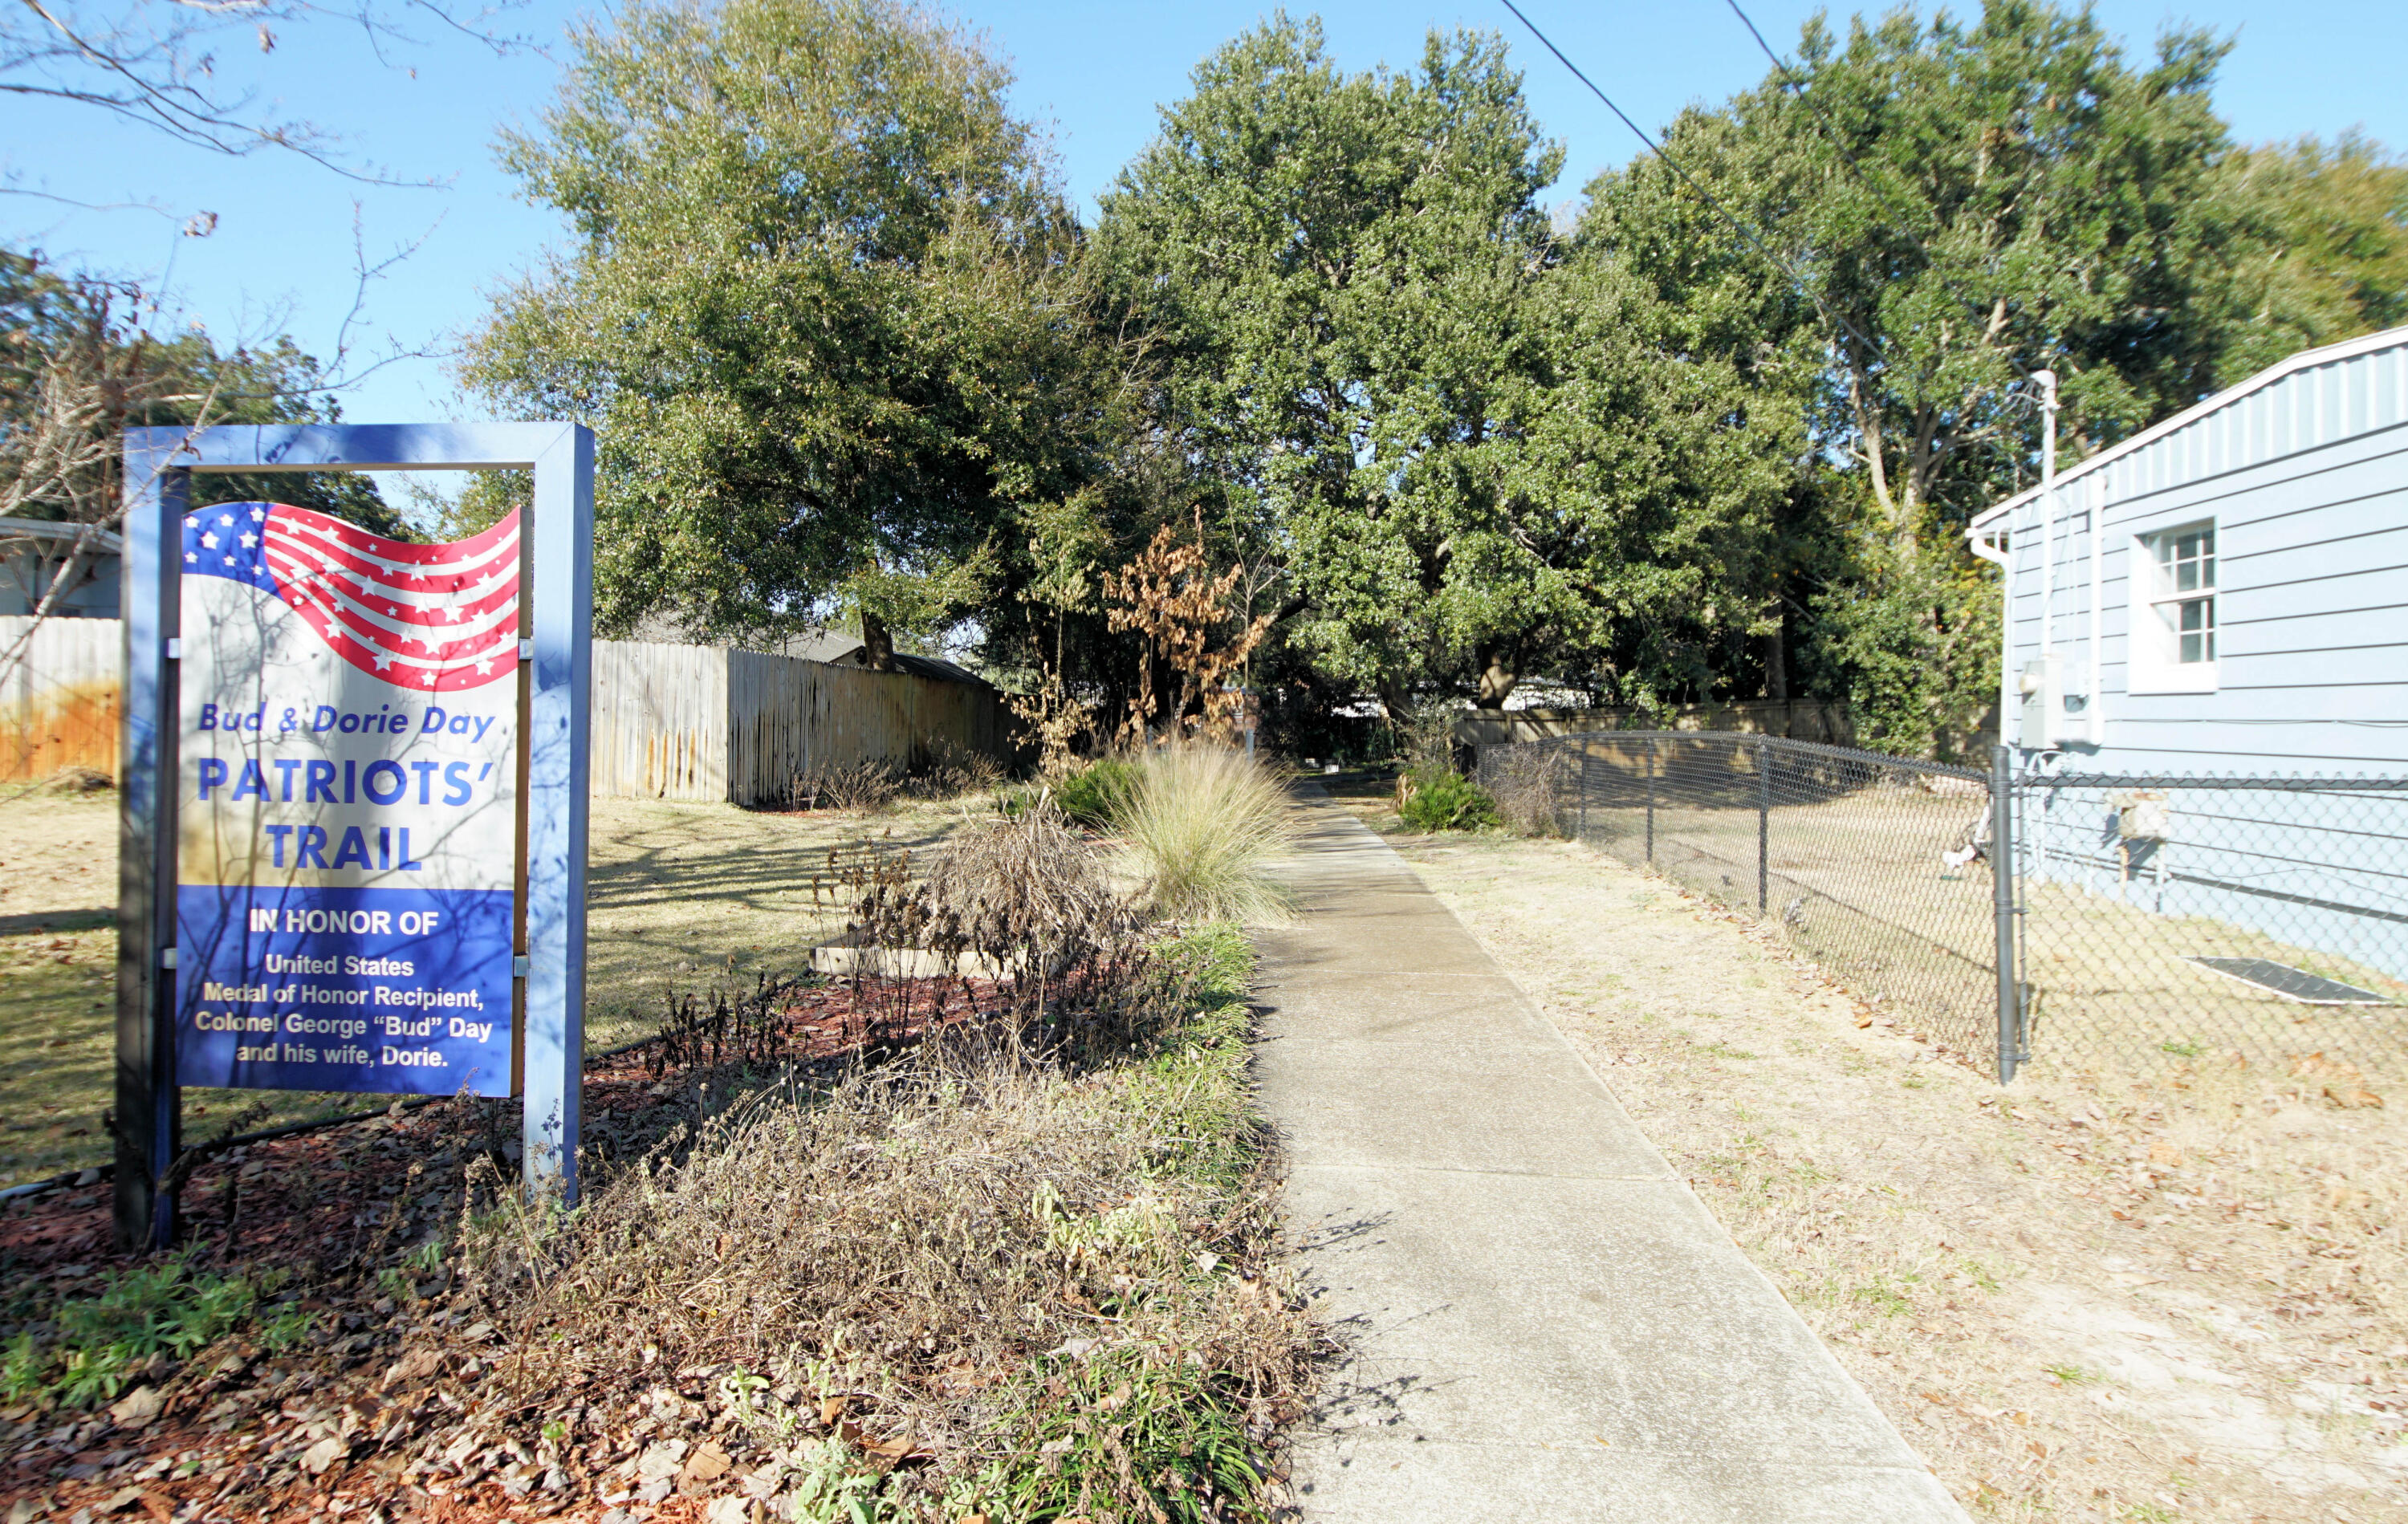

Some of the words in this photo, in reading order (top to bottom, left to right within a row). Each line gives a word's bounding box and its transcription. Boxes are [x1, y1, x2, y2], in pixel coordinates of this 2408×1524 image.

[199, 701, 267, 731] Bud
[279, 706, 298, 732] &
[311, 704, 409, 734] Dorie
[421, 706, 495, 744] Day
[266, 824, 421, 871] TRAIL
[250, 908, 278, 933] IN
[286, 909, 392, 935] HONOR
[399, 912, 438, 935] OF
[266, 953, 337, 974] United
[344, 955, 414, 976] States
[204, 982, 267, 1003] Medal
[273, 983, 295, 1003] of
[302, 985, 368, 1005] Honor
[374, 986, 483, 1011] Recipient,
[195, 1011, 279, 1033] Colonel
[285, 1014, 367, 1038] George
[449, 1018, 492, 1042] Day
[237, 1042, 278, 1062] and
[284, 1043, 316, 1063] his
[323, 1045, 374, 1068] wife,
[382, 1046, 448, 1067] Dorie.
